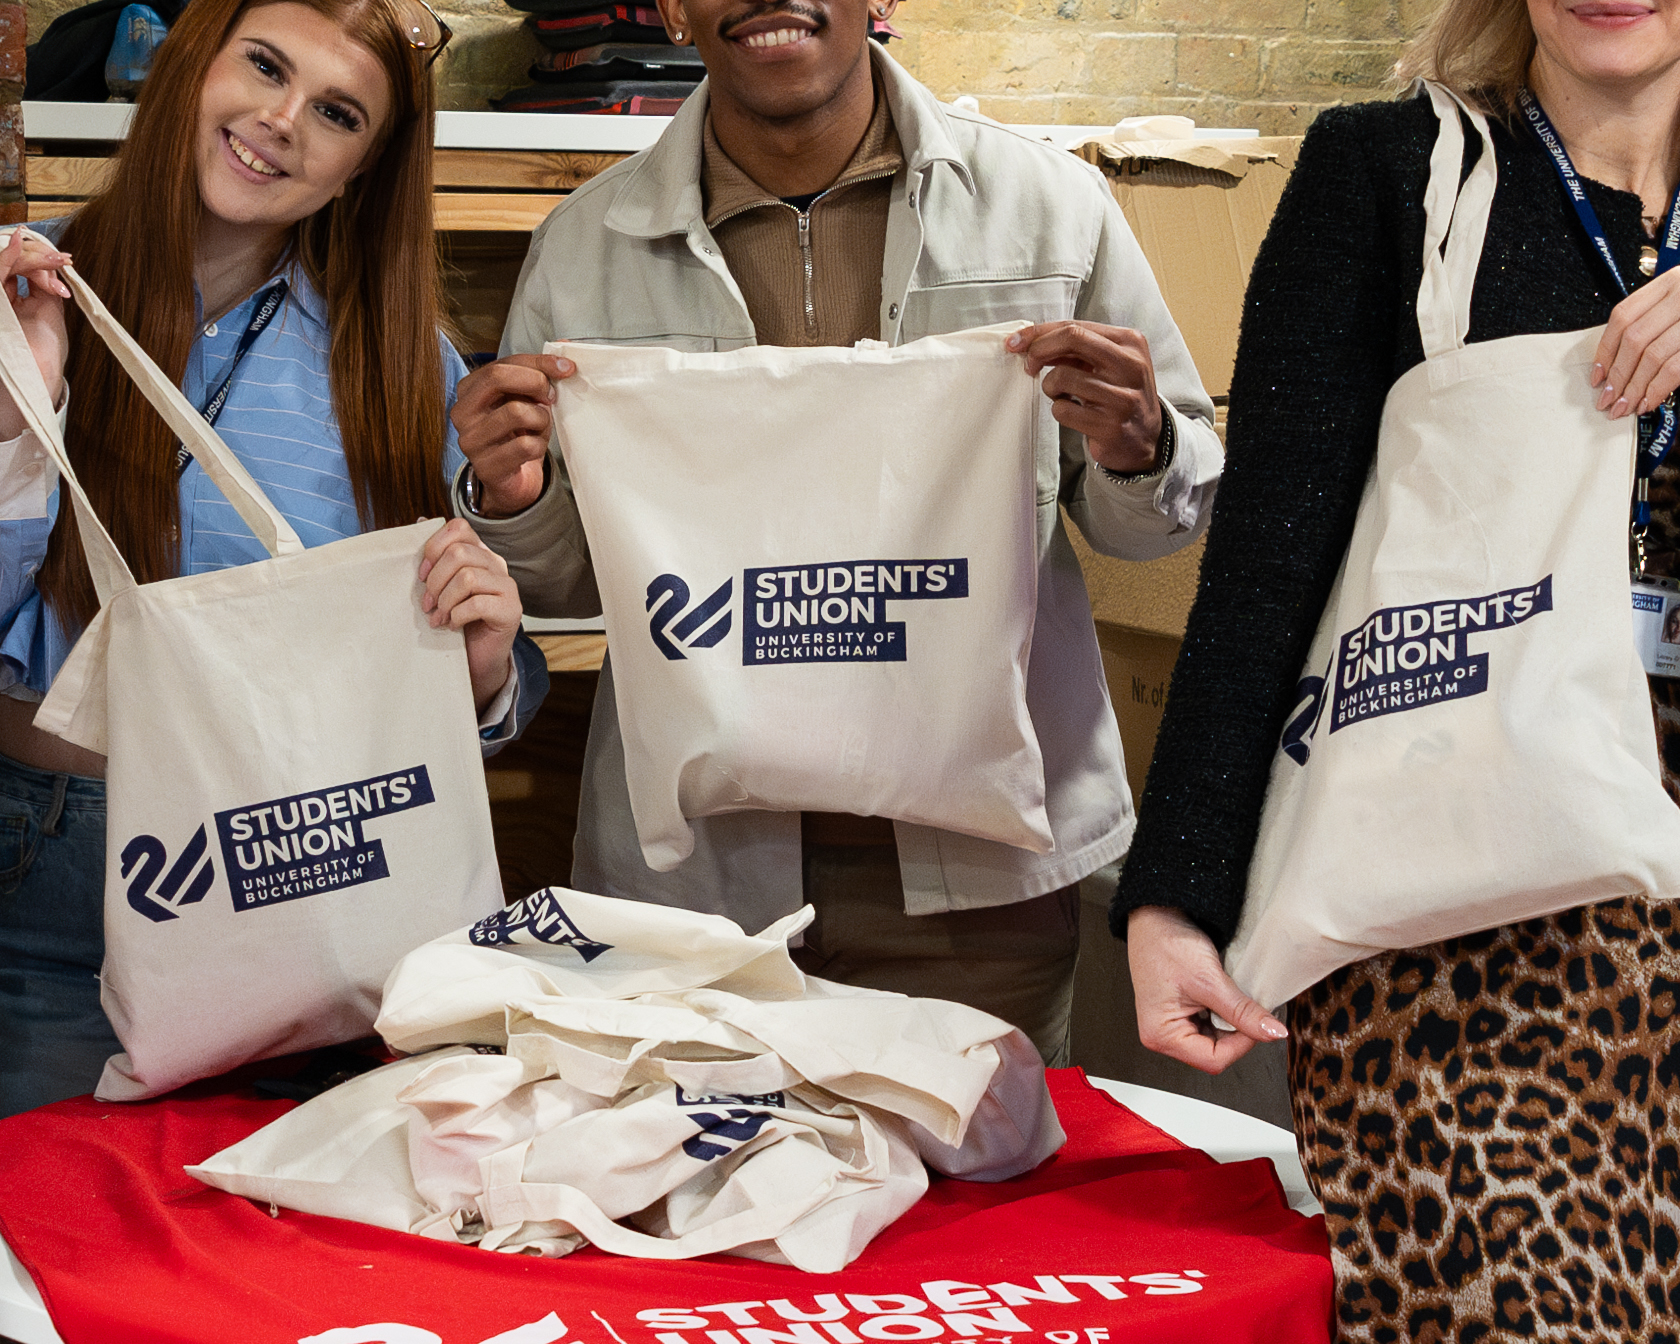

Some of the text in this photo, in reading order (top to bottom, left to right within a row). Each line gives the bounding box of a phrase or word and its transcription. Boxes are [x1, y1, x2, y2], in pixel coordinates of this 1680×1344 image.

[1524, 106, 1540, 121] OF
[1533, 119, 1575, 177] UNIVERSITY
[1566, 179, 1586, 201] THE
[755, 563, 956, 599] STUDENTS'
[755, 596, 877, 629] UNION
[1346, 586, 1544, 661] STUDENTS'
[755, 631, 897, 647] UNIVERSITY OF
[755, 645, 879, 660] BUCKINGHAM
[1342, 634, 1457, 690] UNION
[1338, 681, 1459, 725] BUCKINGHAM
[1339, 664, 1479, 710] UNIVERSITY OF
[229, 773, 417, 842] STUDENTS'
[234, 821, 357, 872] UNION
[242, 850, 376, 891] UNIVERSITY OF
[244, 866, 364, 905] BUCKINGHAM
[635, 1270, 1210, 1326] STUDENTS'
